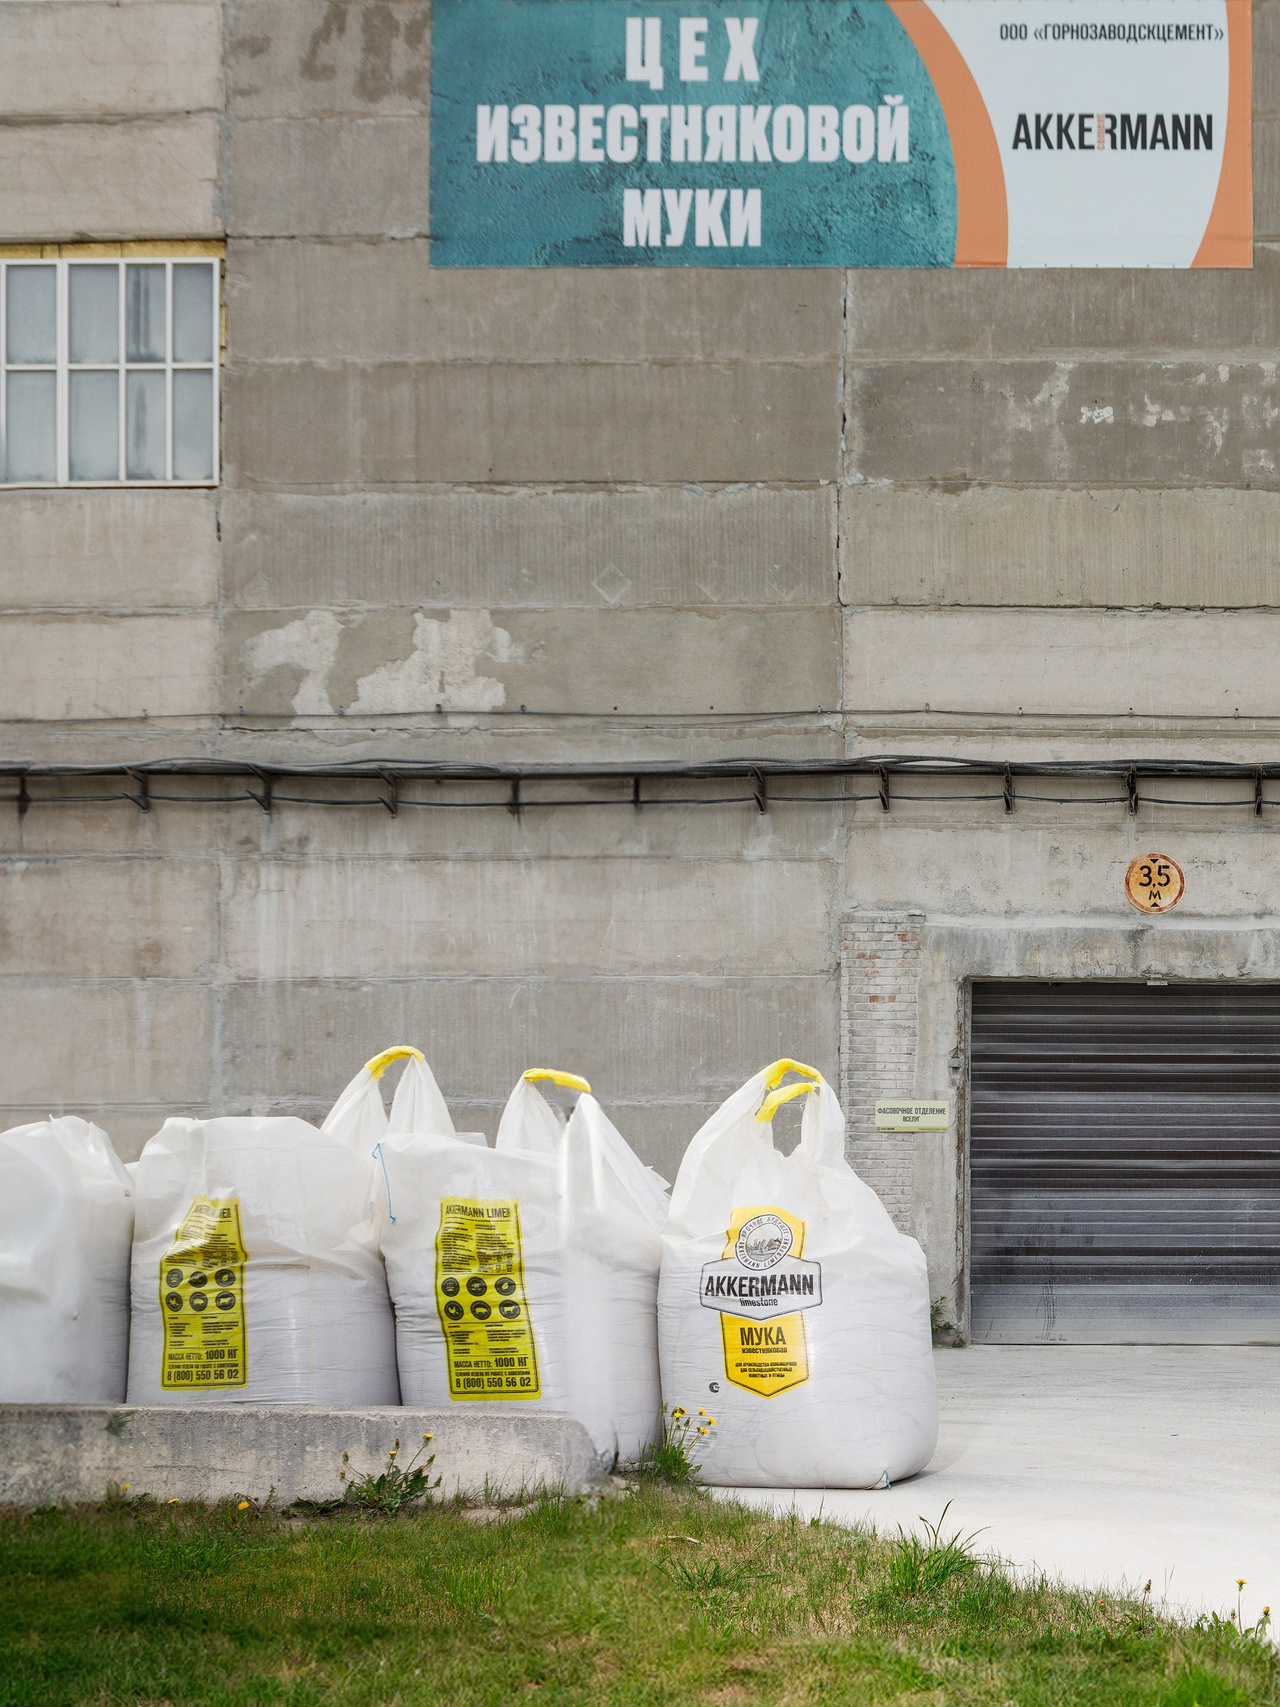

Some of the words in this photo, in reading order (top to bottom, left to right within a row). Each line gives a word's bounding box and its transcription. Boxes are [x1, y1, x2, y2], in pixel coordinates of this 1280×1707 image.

[1000, 24, 1028, 41] ООО
[1033, 23, 1225, 43] «ГОРНОЗАВОДСКЦЕМЕНТ»
[625, 17, 761, 91] ЦЕХ
[475, 95, 909, 164] ИЗВЕСТНЯКОВОЙ
[1012, 113, 1213, 151] AKKERMANN
[623, 188, 762, 248] МУКИ
[1139, 864, 1171, 888] 3,5
[877, 1107, 913, 1115] ФАСОВОЧНОЕ
[914, 1107, 946, 1116] ОТДЕЛЕНИЕ
[704, 1274, 814, 1297] AKKERMANN
[740, 1326, 787, 1346] МУКА
[205, 1349, 225, 1360] 1000
[494, 1356, 515, 1367] 1000
[167, 1370, 172, 1381] 8
[174, 1370, 193, 1382] (800)
[196, 1370, 211, 1380] 550
[214, 1369, 225, 1380] 56
[227, 1369, 239, 1379] 02
[455, 1378, 461, 1388] 8
[463, 1378, 484, 1389] (800)
[487, 1377, 503, 1387] 550
[505, 1377, 517, 1387] 56
[520, 1376, 532, 1387] 02
